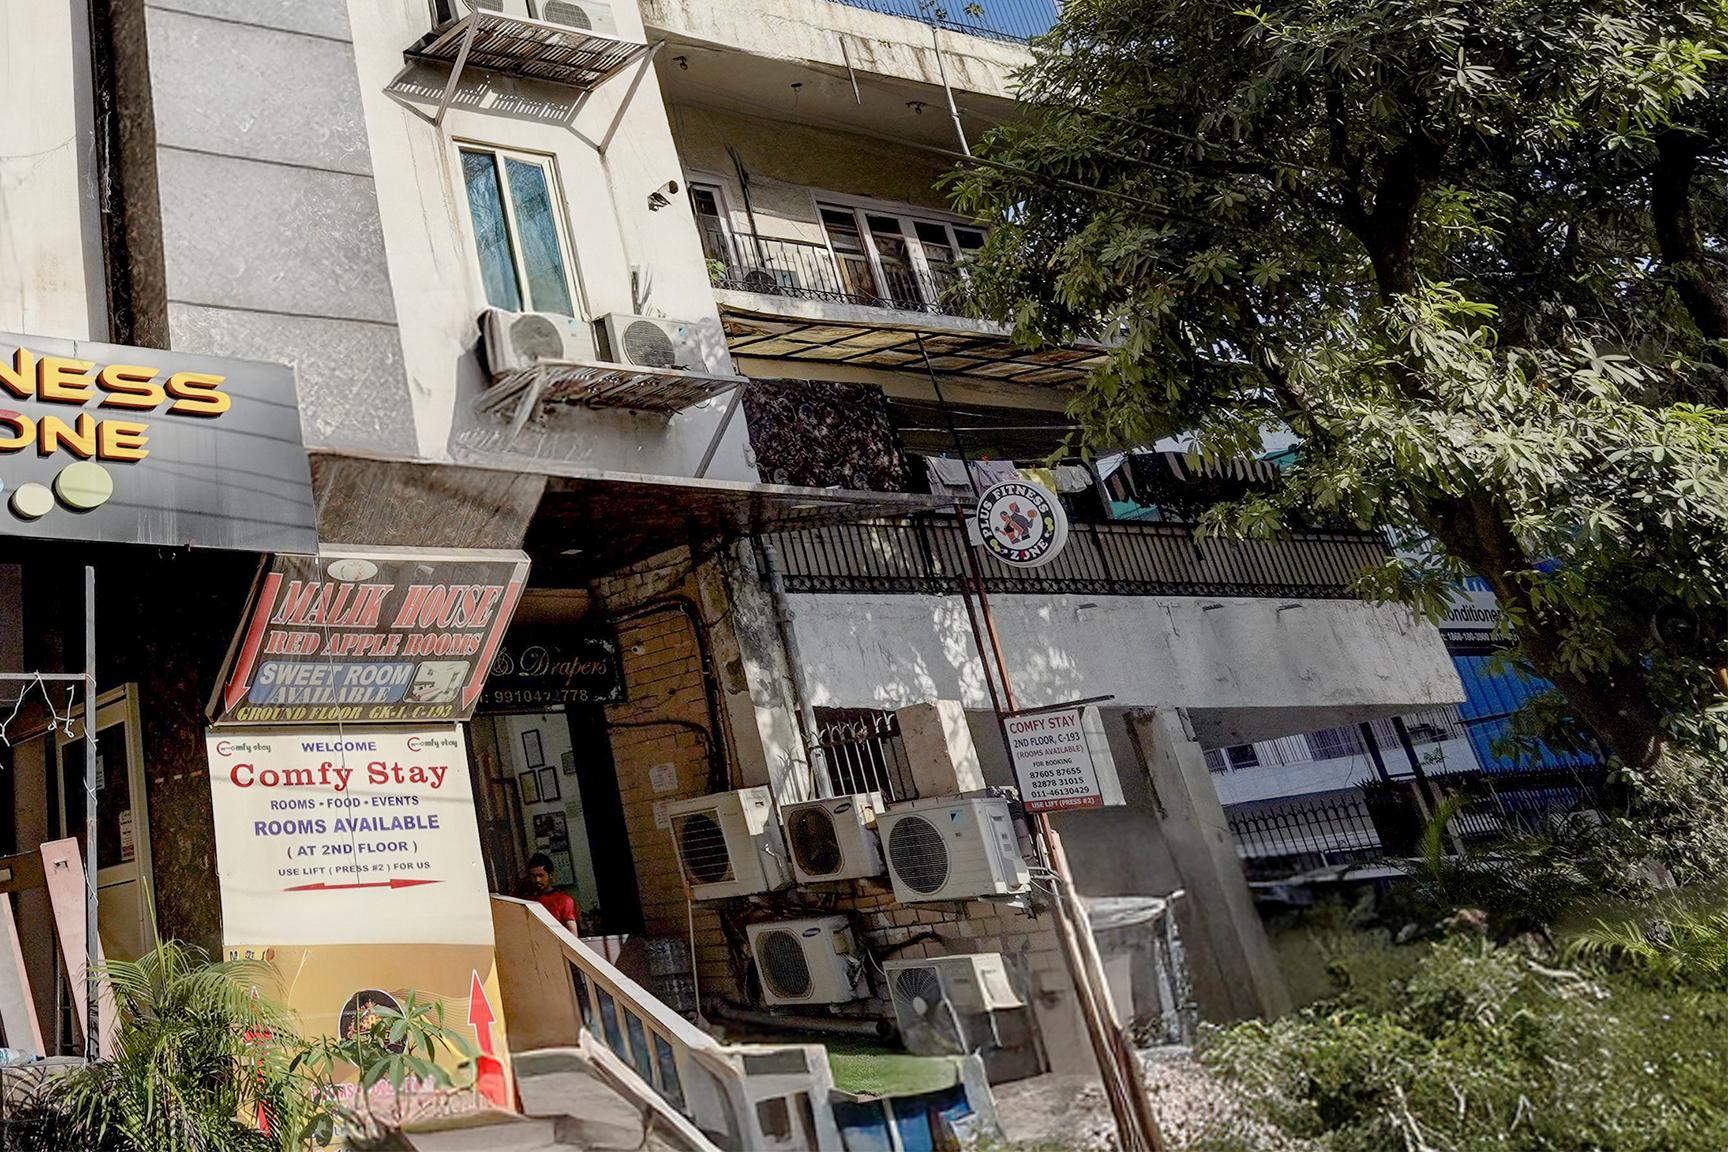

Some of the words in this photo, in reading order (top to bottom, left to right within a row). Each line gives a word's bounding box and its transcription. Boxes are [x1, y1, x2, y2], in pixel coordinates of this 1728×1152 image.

[979, 500, 993, 538] PLUS
[992, 485, 1049, 513] FITNESS
[1011, 539, 1048, 560] ZONE
[270, 580, 395, 628] MALIK
[391, 583, 504, 629] HOUSE
[263, 630, 321, 656] RED
[320, 633, 403, 656] APPLE
[401, 632, 484, 657] ROOMS
[519, 645, 607, 686] Drapers
[259, 662, 342, 686] SWEET
[342, 664, 414, 687] ROOM
[270, 685, 392, 704] AVAILABLE
[236, 705, 307, 721] GROUND
[308, 705, 363, 721] FLOOR
[411, 704, 454, 719] C-193
[1009, 719, 1045, 734] COMFY
[1048, 715, 1075, 729] STAY
[301, 741, 377, 753] WELCOME
[1013, 739, 1029, 748] 2ND
[1030, 735, 1057, 746] FLOOR,
[1058, 732, 1080, 743] C-193
[1017, 749, 1043, 760] (ROOMS
[1044, 744, 1084, 756] AVAILABLE)
[1045, 758, 1073, 767] BOOKING
[229, 761, 354, 792] Comfy
[367, 761, 449, 790] Stay
[1029, 770, 1054, 779] 87605
[1056, 767, 1082, 777] 87655
[1032, 779, 1057, 788] 82878
[1059, 777, 1084, 786] 31015
[1031, 786, 1090, 798] 011-46130429
[270, 799, 316, 811] ROOMS
[327, 797, 361, 809] FOOD
[372, 795, 419, 807] EVENTS
[1032, 801, 1044, 809] USE
[1045, 800, 1059, 808] LIFT
[1059, 798, 1081, 808] (PRESS
[254, 818, 327, 837] ROOMS
[333, 814, 440, 833] AVAILABLE
[297, 845, 316, 857] AT
[321, 844, 353, 856] 2ND
[358, 841, 409, 854] FLOOR
[278, 867, 300, 877] USE
[302, 866, 326, 876] LIFT
[335, 864, 369, 874] PRESS
[393, 862, 414, 871] FOR
[416, 861, 431, 870] US
